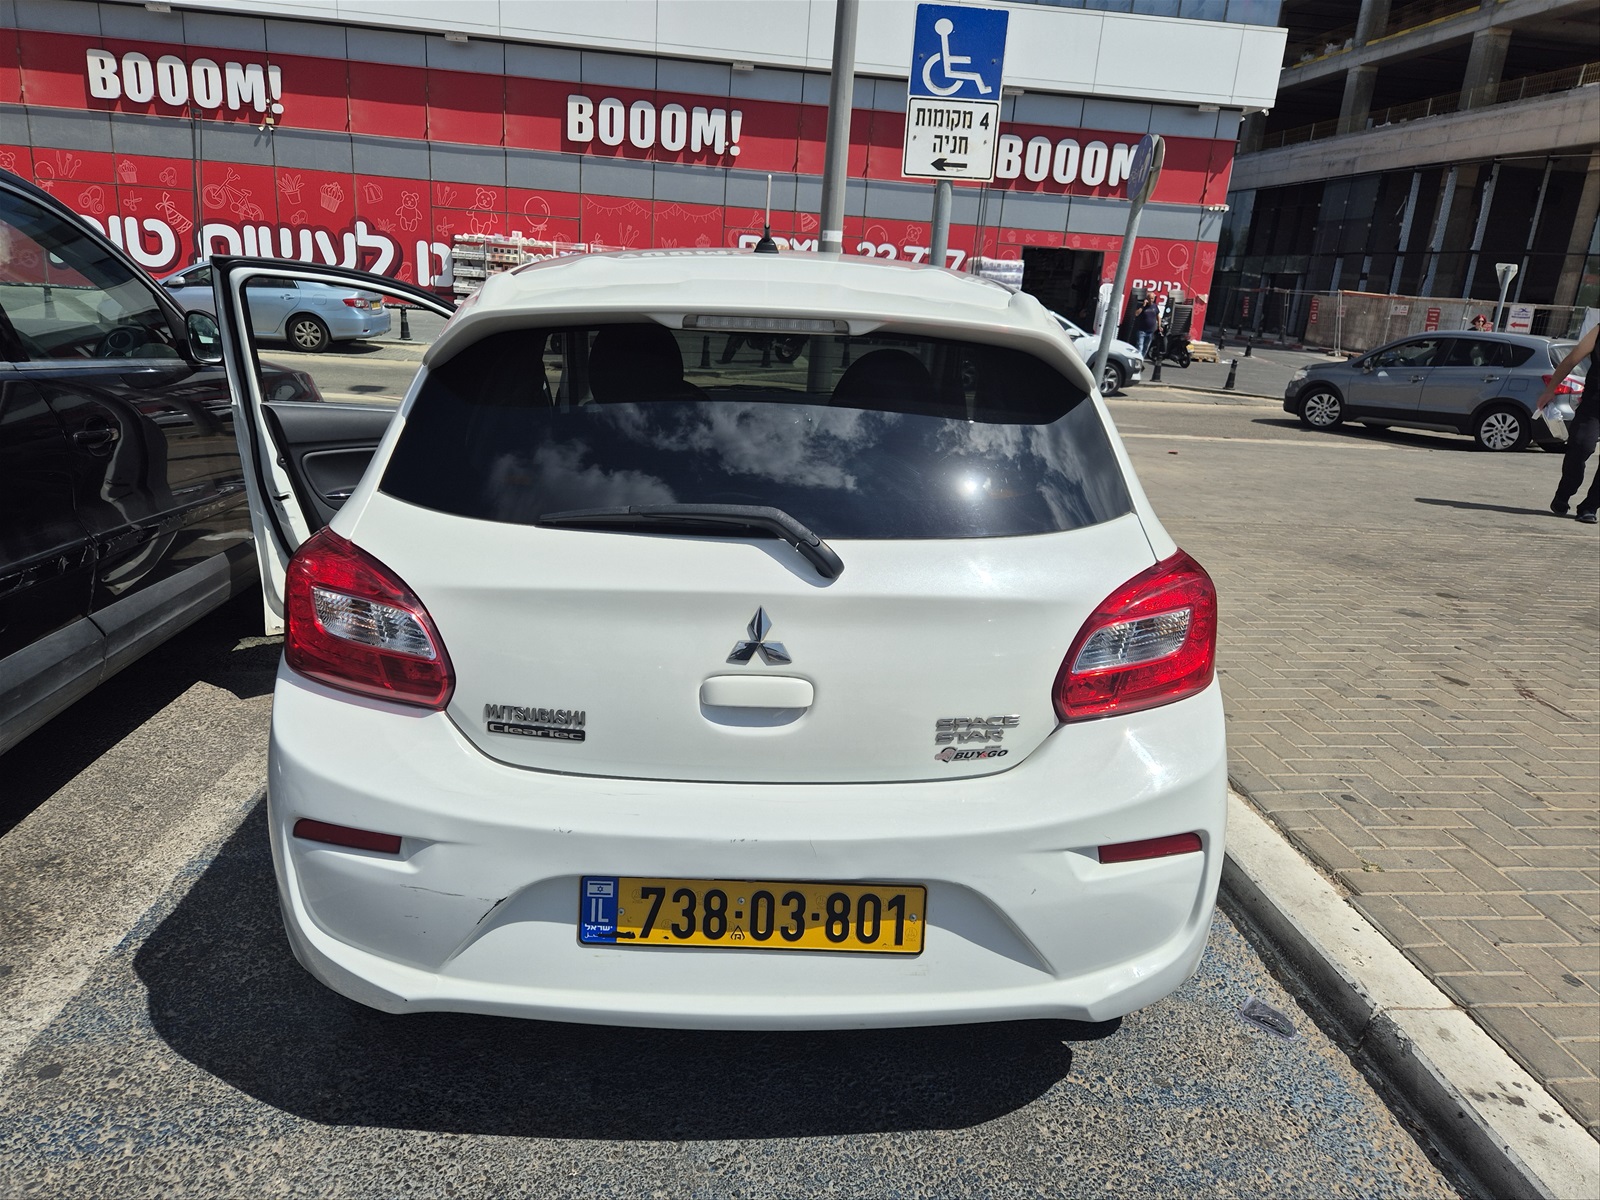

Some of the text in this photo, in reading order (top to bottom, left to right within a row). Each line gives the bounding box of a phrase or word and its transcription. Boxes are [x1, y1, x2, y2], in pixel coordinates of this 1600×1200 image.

[86, 48, 284, 115] BOOOM!
[567, 94, 743, 157] BOOOM!
[915, 108, 989, 131] 4 מקומות
[932, 134, 968, 155] חניה
[996, 134, 1138, 187] BOOOM
[483, 703, 585, 727] MITSUBISHI
[935, 715, 1020, 732] SPACE
[489, 723, 583, 740] ClearTec
[934, 729, 1004, 745] STAR
[591, 898, 609, 923] IL
[584, 923, 613, 931] ישראל
